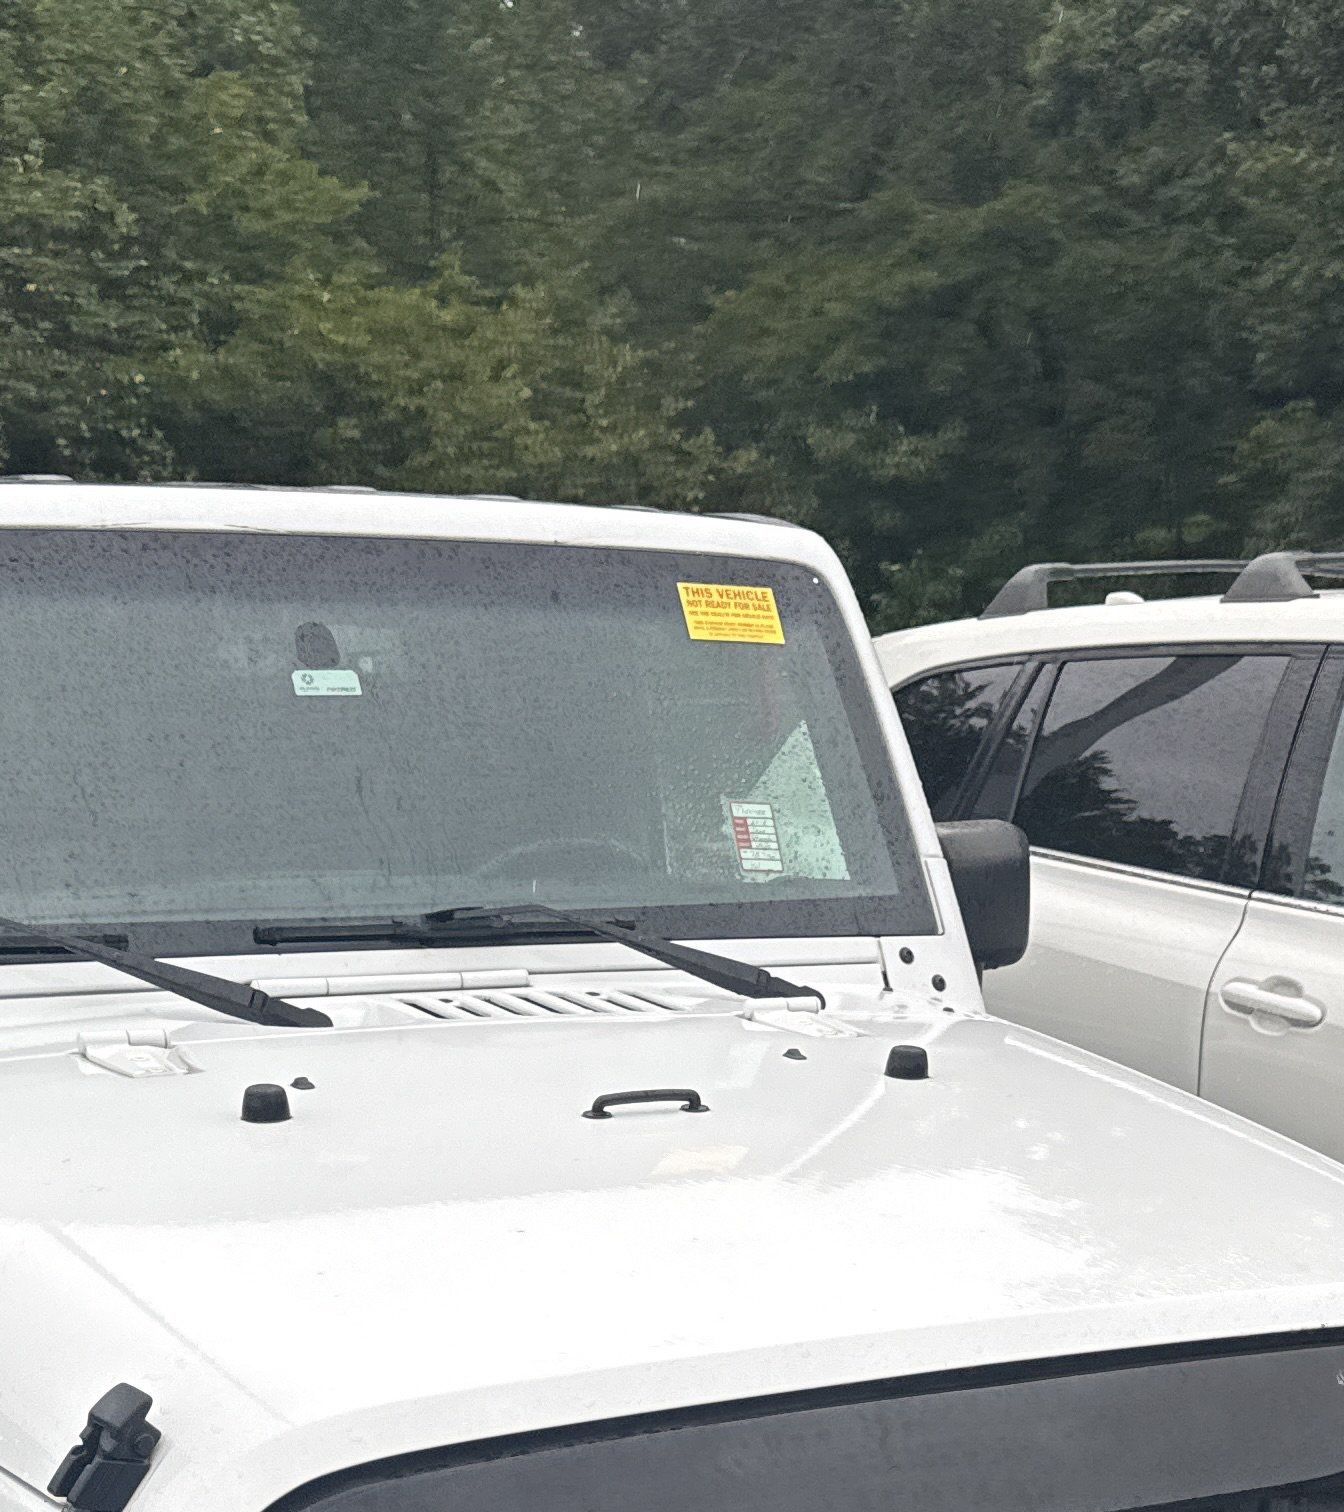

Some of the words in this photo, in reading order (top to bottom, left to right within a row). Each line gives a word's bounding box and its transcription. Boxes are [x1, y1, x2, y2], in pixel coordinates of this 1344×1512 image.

[682, 586, 713, 598] THIS
[716, 588, 769, 602] VEHICLE
[686, 600, 702, 608] NOT
[704, 600, 731, 610] READY
[734, 601, 750, 611] FOR
[752, 602, 771, 612] SALE
